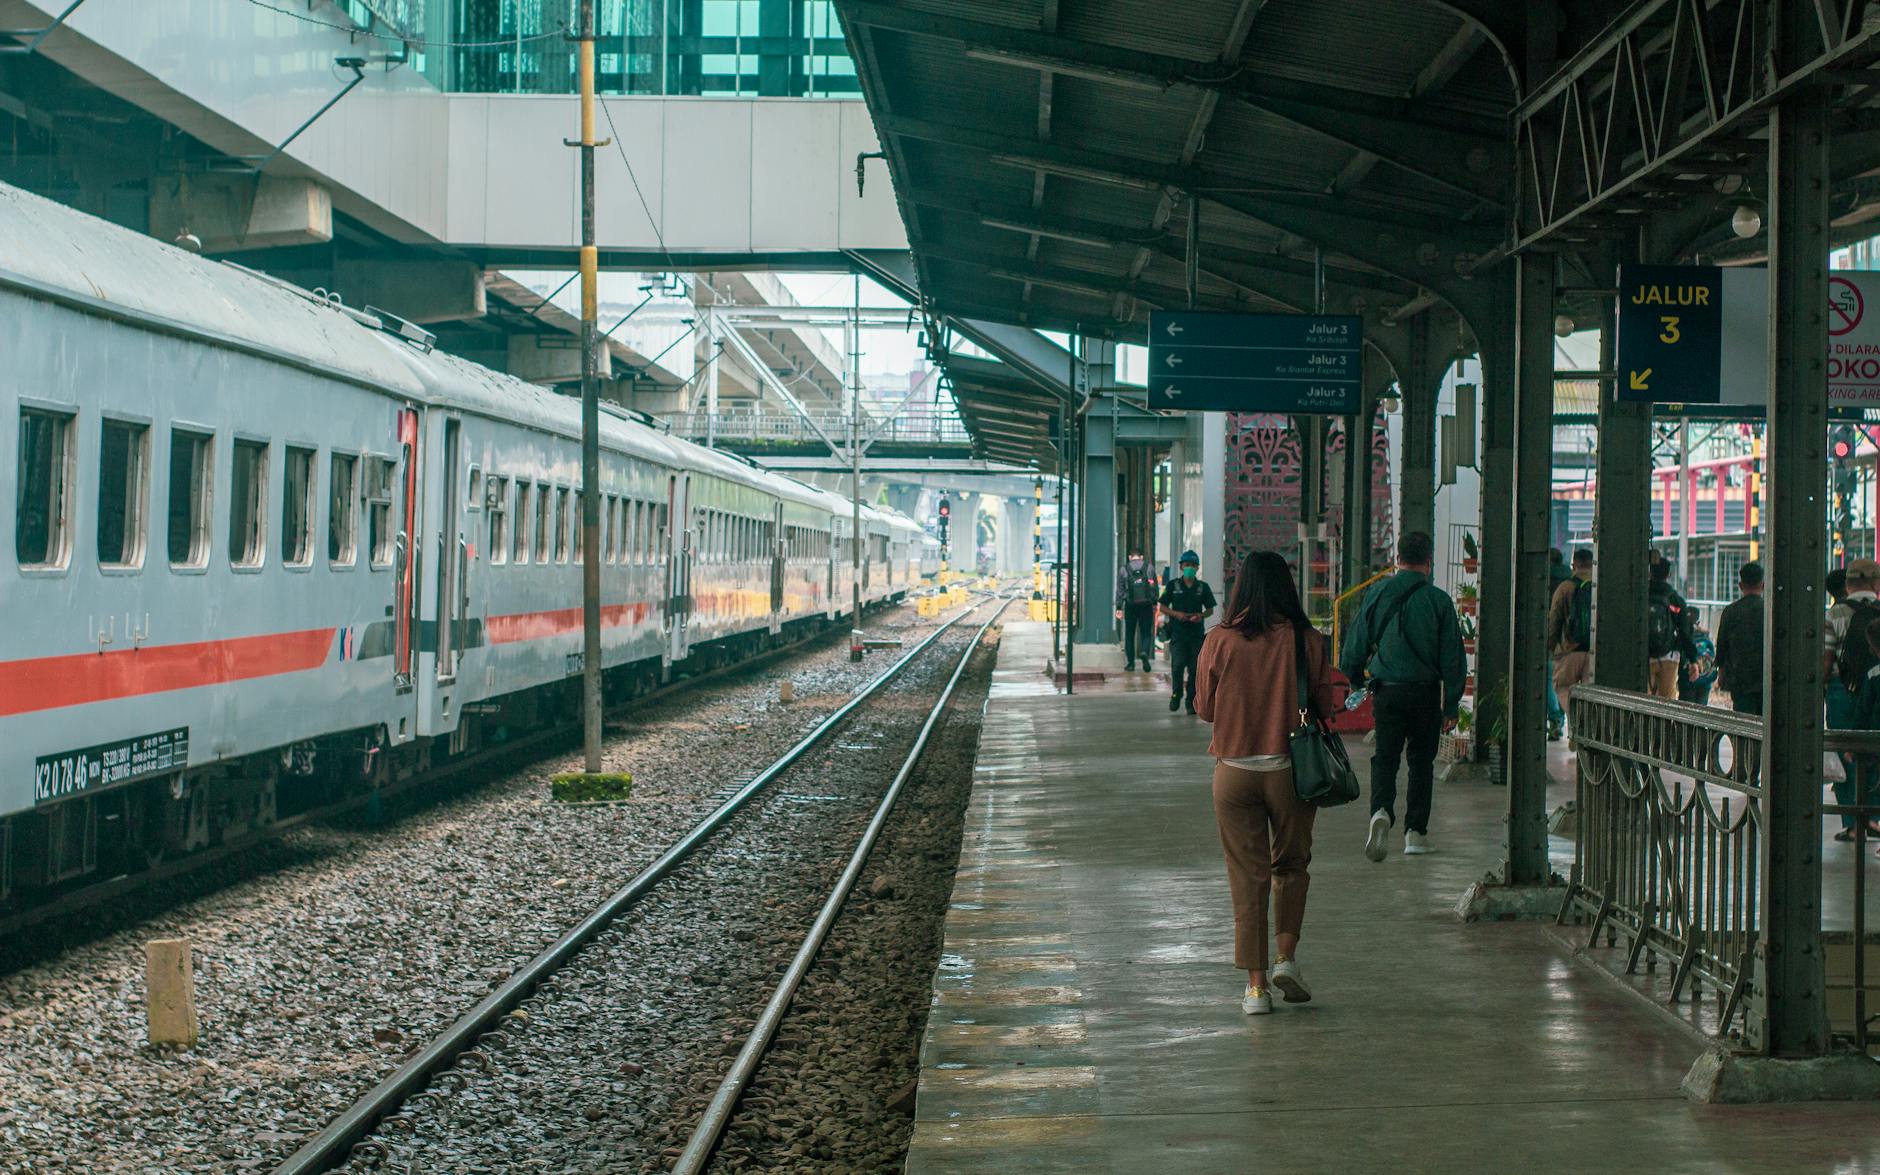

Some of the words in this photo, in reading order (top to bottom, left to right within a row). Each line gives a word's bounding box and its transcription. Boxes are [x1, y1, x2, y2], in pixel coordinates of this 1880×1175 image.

[1631, 285, 1710, 305] JALUR
[1309, 324, 1338, 334] Jalur
[1341, 325, 1348, 334] 3
[1659, 316, 1681, 344] 3
[1308, 354, 1337, 365] Jalur
[1339, 356, 1347, 365] 3
[1317, 367, 1346, 375] Express
[1306, 387, 1336, 397] Jalur
[1338, 388, 1346, 397] 3
[35, 763, 50, 800] K2
[52, 761, 59, 796] 0
[61, 757, 73, 794] 78
[75, 754, 87, 790] 46
